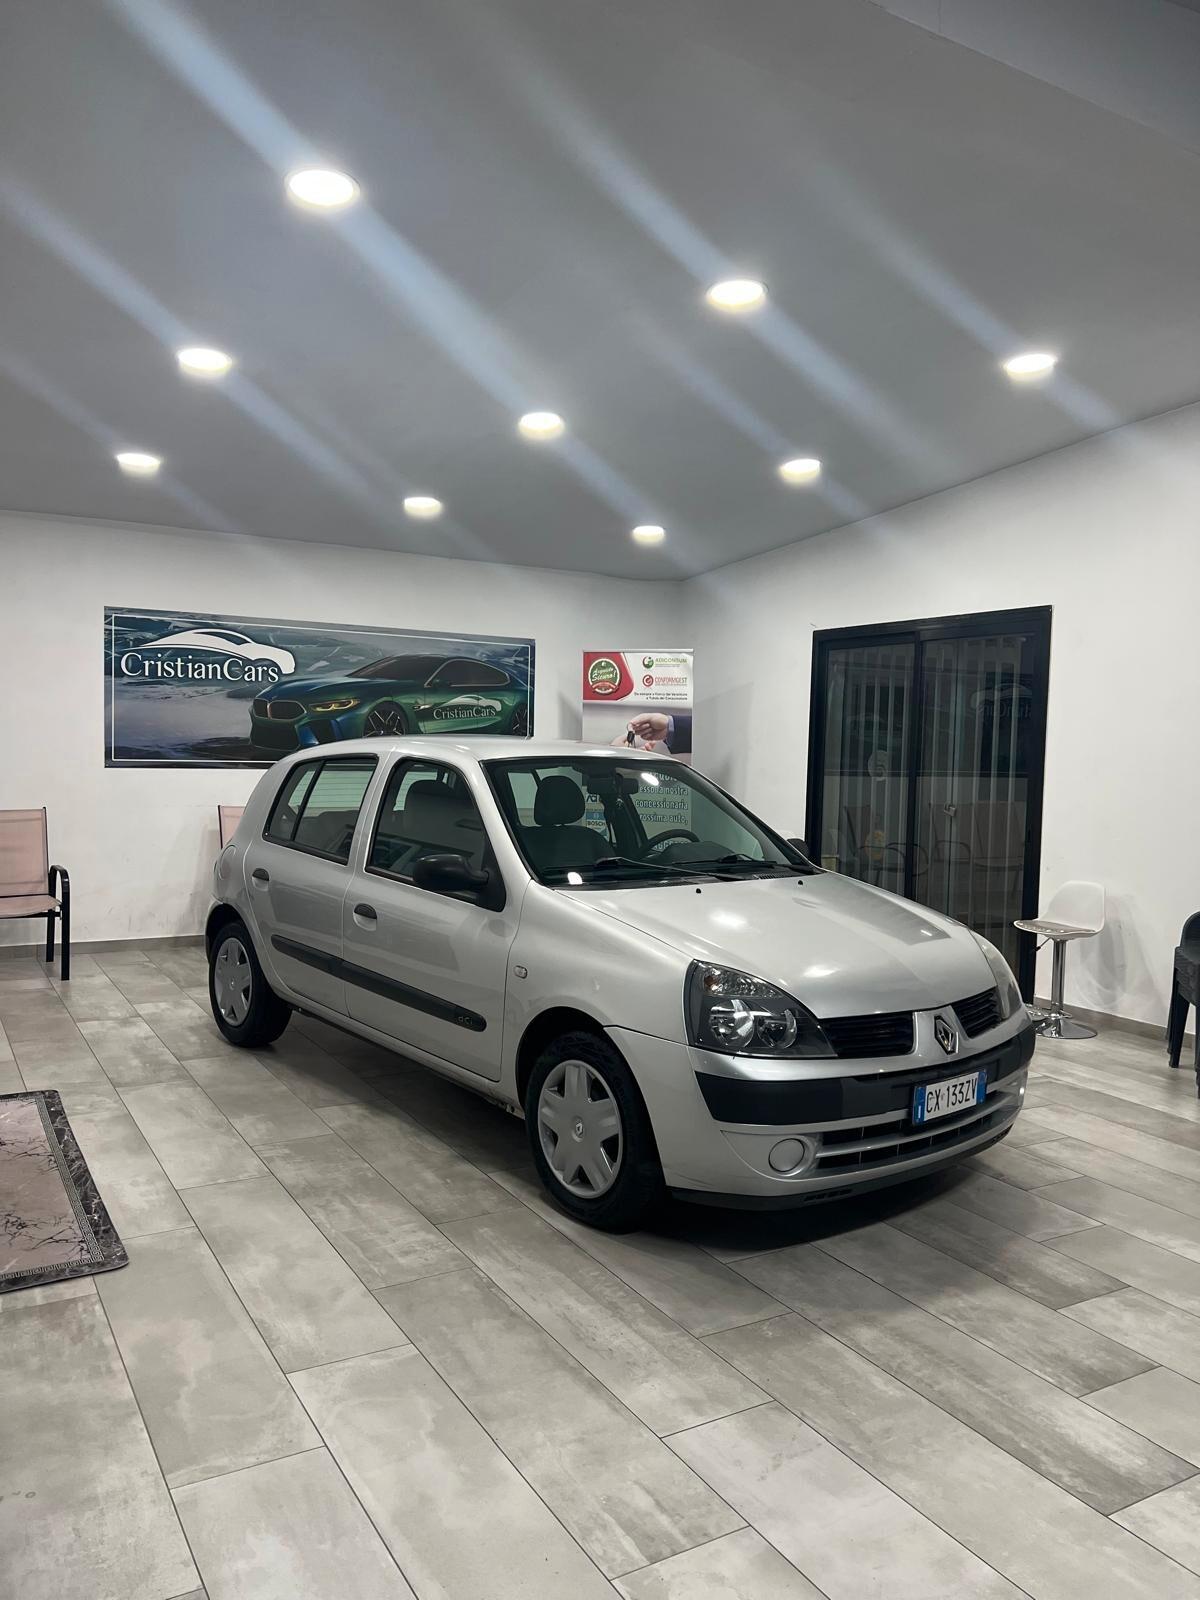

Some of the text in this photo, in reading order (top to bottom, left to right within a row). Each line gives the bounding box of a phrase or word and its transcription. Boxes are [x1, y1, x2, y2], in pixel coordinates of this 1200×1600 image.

[120, 652, 279, 683] CristianCars
[433, 706, 496, 720] CristianCars
[665, 786, 689, 796] nostra
[635, 798, 689, 810] concessionaria
[639, 813, 669, 822] rossima
[946, 1078, 978, 1108] 133ZV
